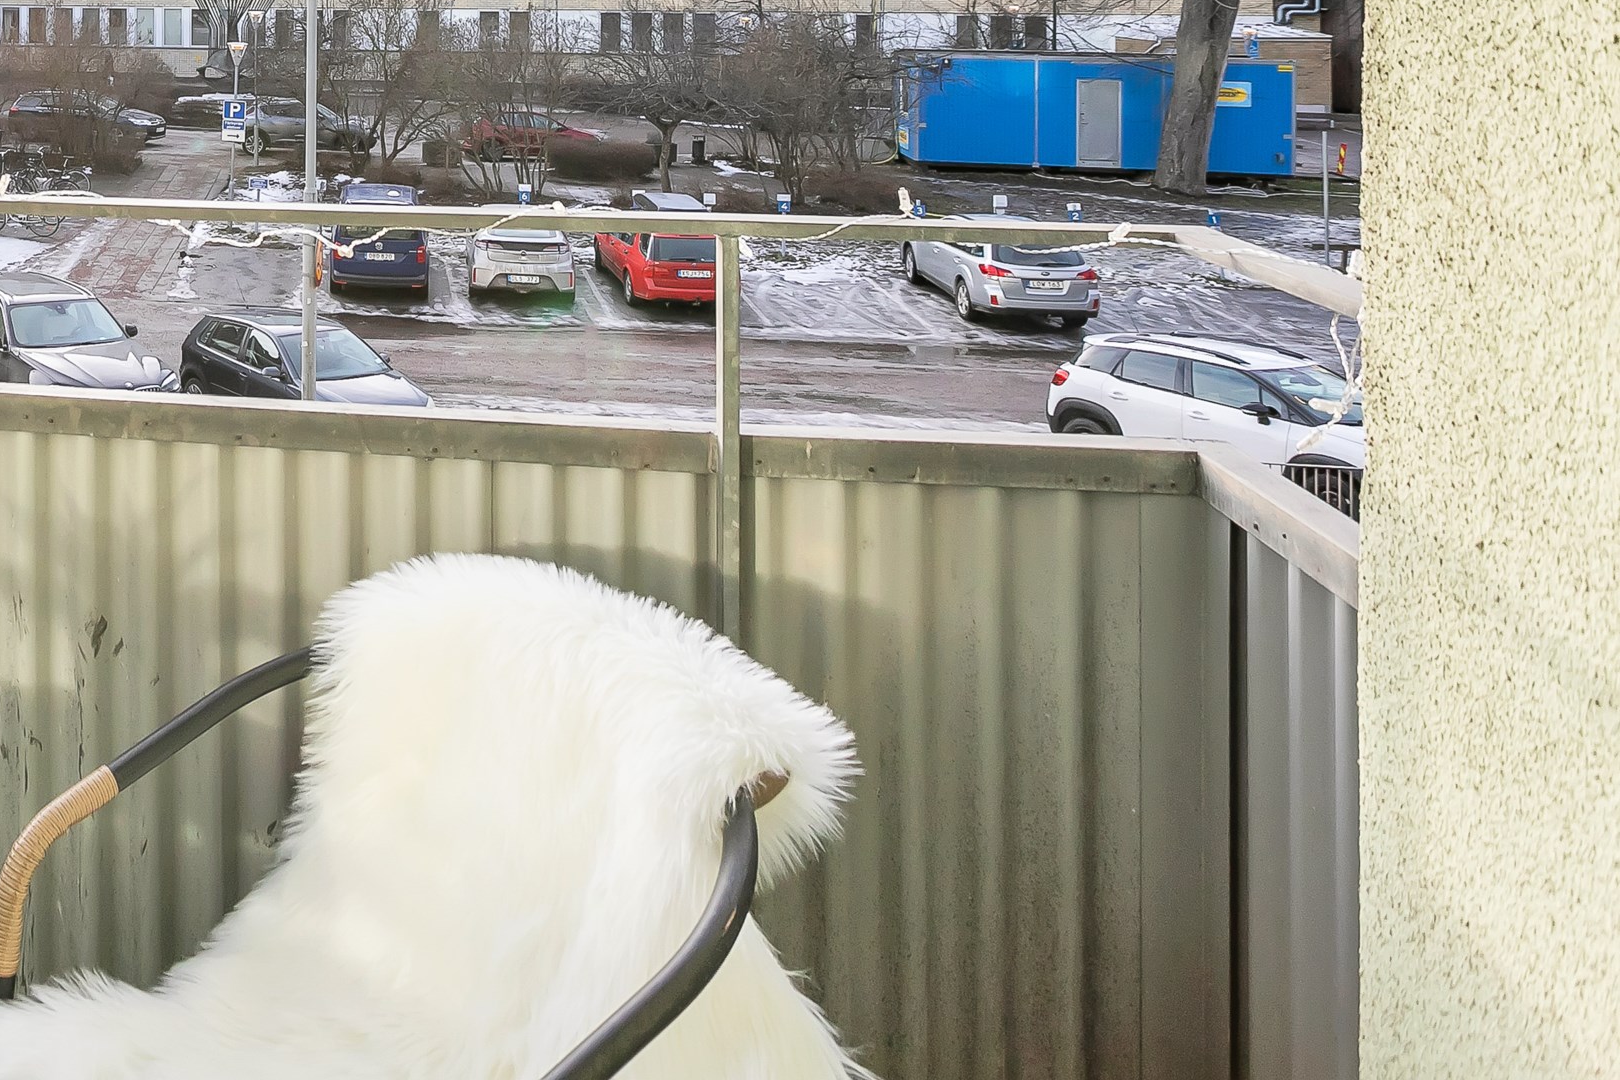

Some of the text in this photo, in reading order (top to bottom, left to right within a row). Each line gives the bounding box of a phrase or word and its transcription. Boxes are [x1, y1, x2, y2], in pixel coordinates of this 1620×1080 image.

[230, 102, 241, 118] P
[521, 192, 528, 201] 6
[780, 202, 788, 210] 4
[916, 206, 923, 215] 3
[1071, 211, 1079, 220] 2
